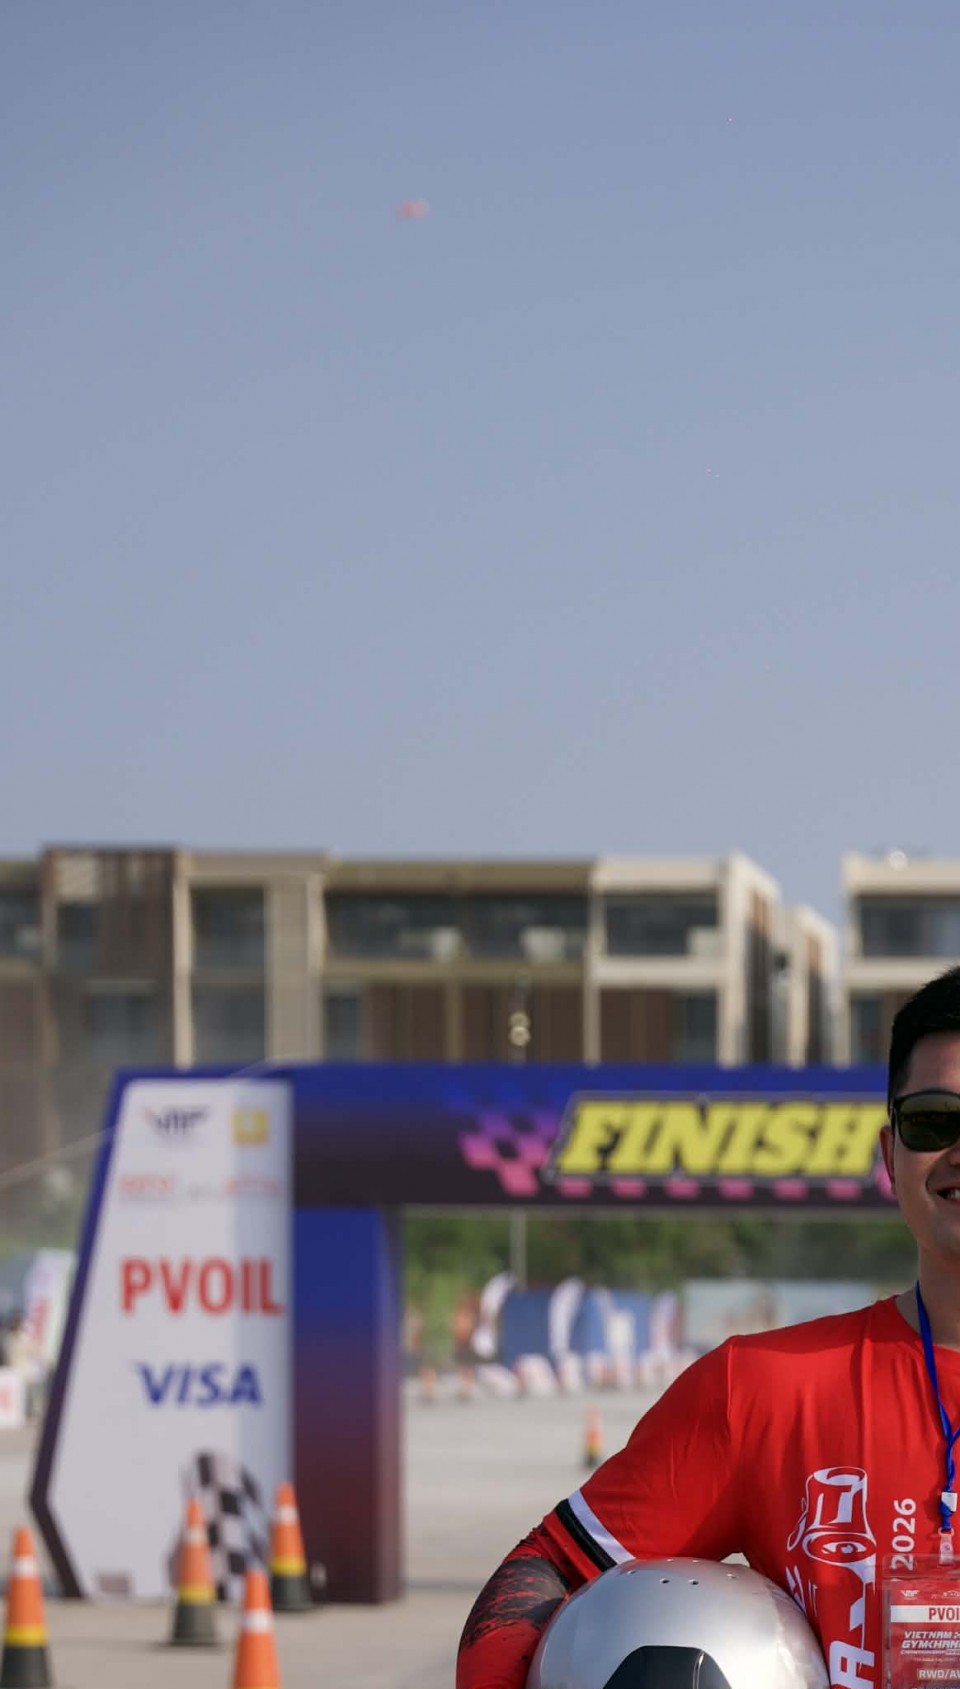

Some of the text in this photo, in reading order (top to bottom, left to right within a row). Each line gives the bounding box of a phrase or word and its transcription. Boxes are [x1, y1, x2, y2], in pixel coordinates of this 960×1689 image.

[556, 1102, 887, 1175] FINISH
[120, 1256, 285, 1316] PVOIL
[137, 1360, 263, 1407] VISA
[892, 1498, 916, 1572] 2026
[904, 1631, 952, 1639] VIETNAM
